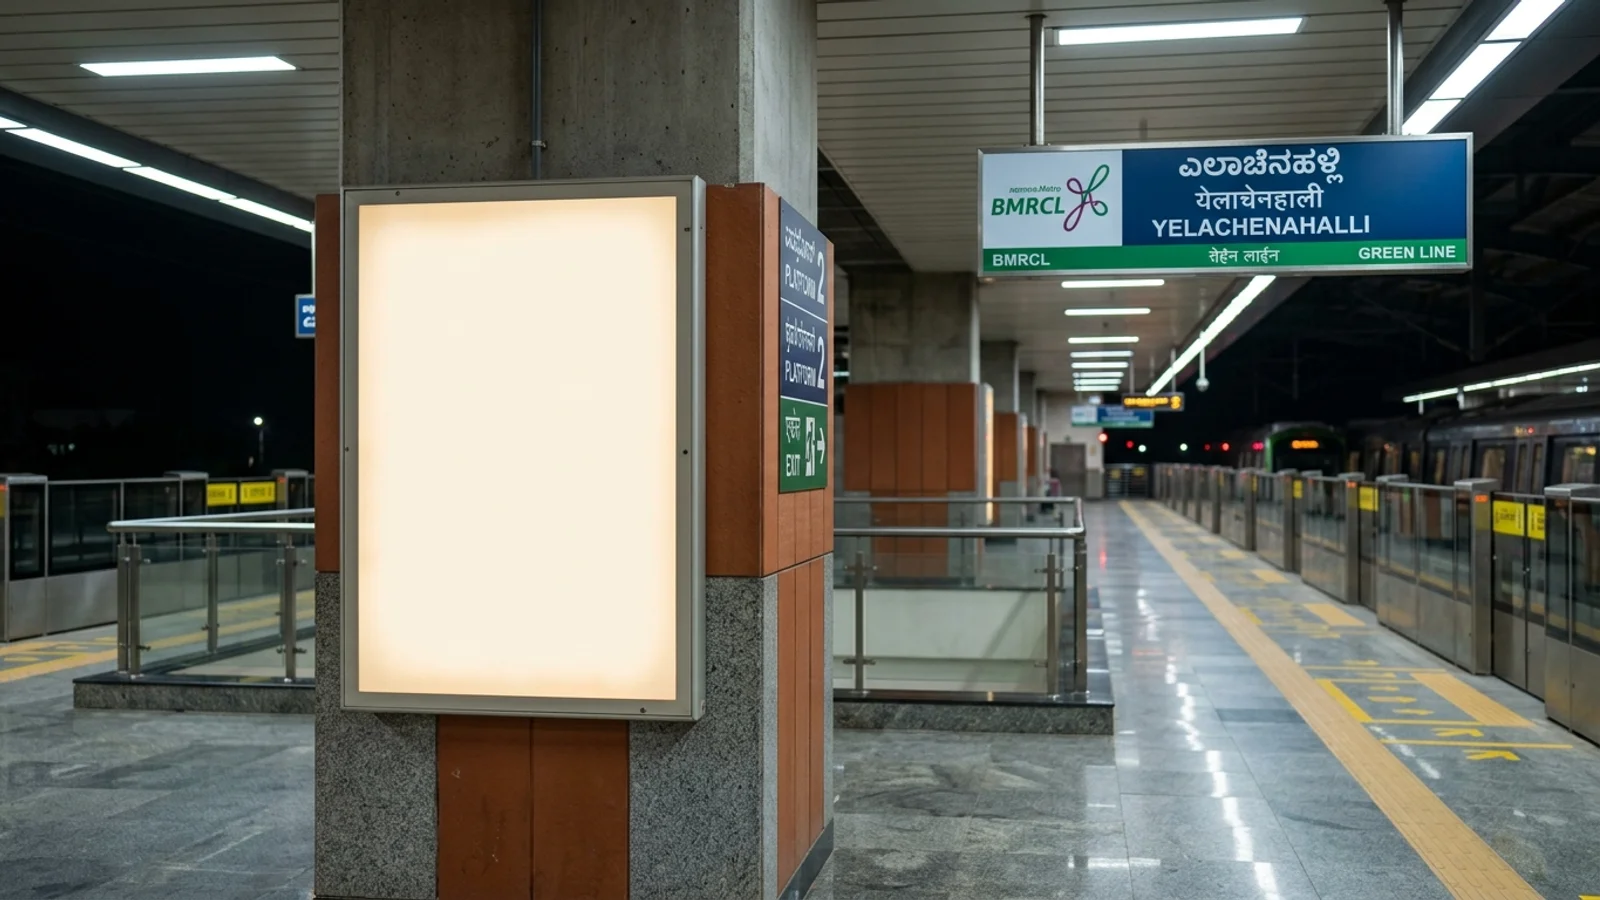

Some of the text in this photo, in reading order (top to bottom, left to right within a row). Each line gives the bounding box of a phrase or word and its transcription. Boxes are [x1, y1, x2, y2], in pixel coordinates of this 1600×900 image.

[991, 196, 1065, 216] BMRCL
[1194, 182, 1325, 211] येलाचेनहाली
[1151, 214, 1370, 238] YELACHENAHALLI
[992, 252, 1051, 267] BMRCL
[1358, 244, 1456, 260] GREEN LINE
[784, 251, 825, 305] PLATFORM 2
[784, 336, 825, 389] PLATFORM 2
[785, 453, 801, 477] EXIT
